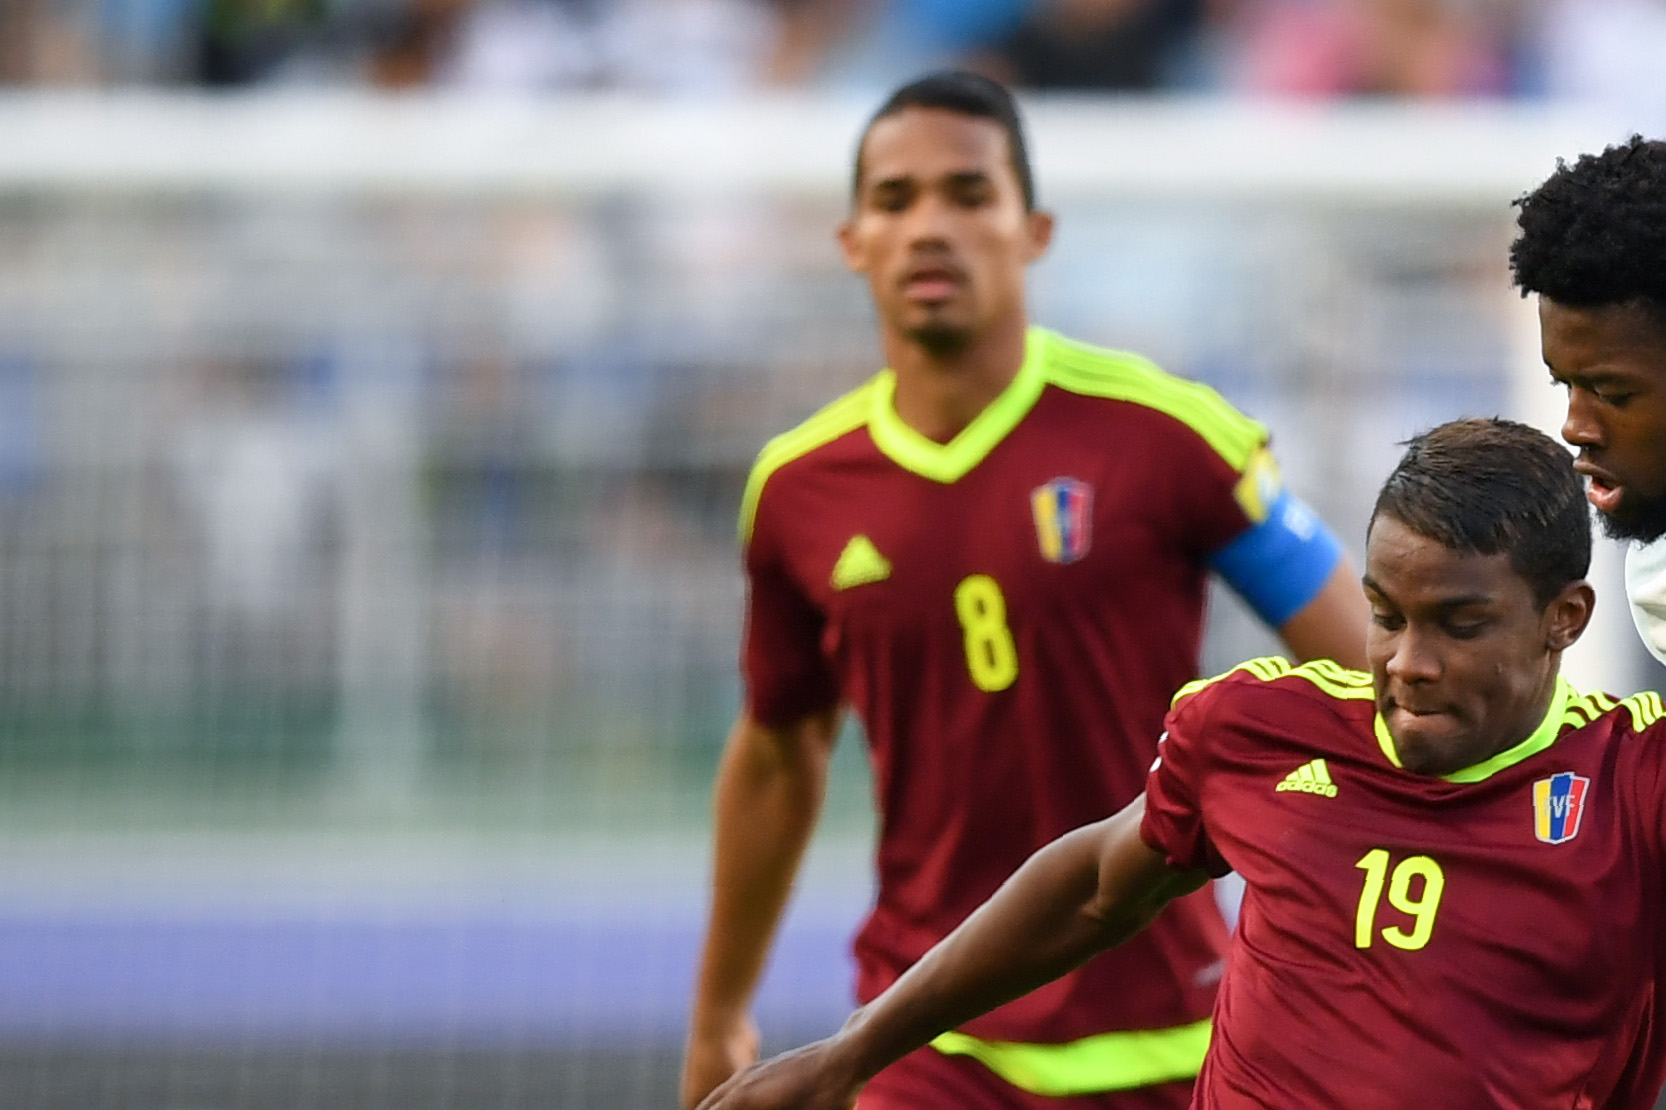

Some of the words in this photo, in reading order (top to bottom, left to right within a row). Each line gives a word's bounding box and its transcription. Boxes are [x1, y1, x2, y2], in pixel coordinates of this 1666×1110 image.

[953, 573, 1018, 693] 8
[1275, 778, 1338, 798] adidas
[1544, 794, 1577, 819] FVF
[1354, 848, 1445, 951] 19
